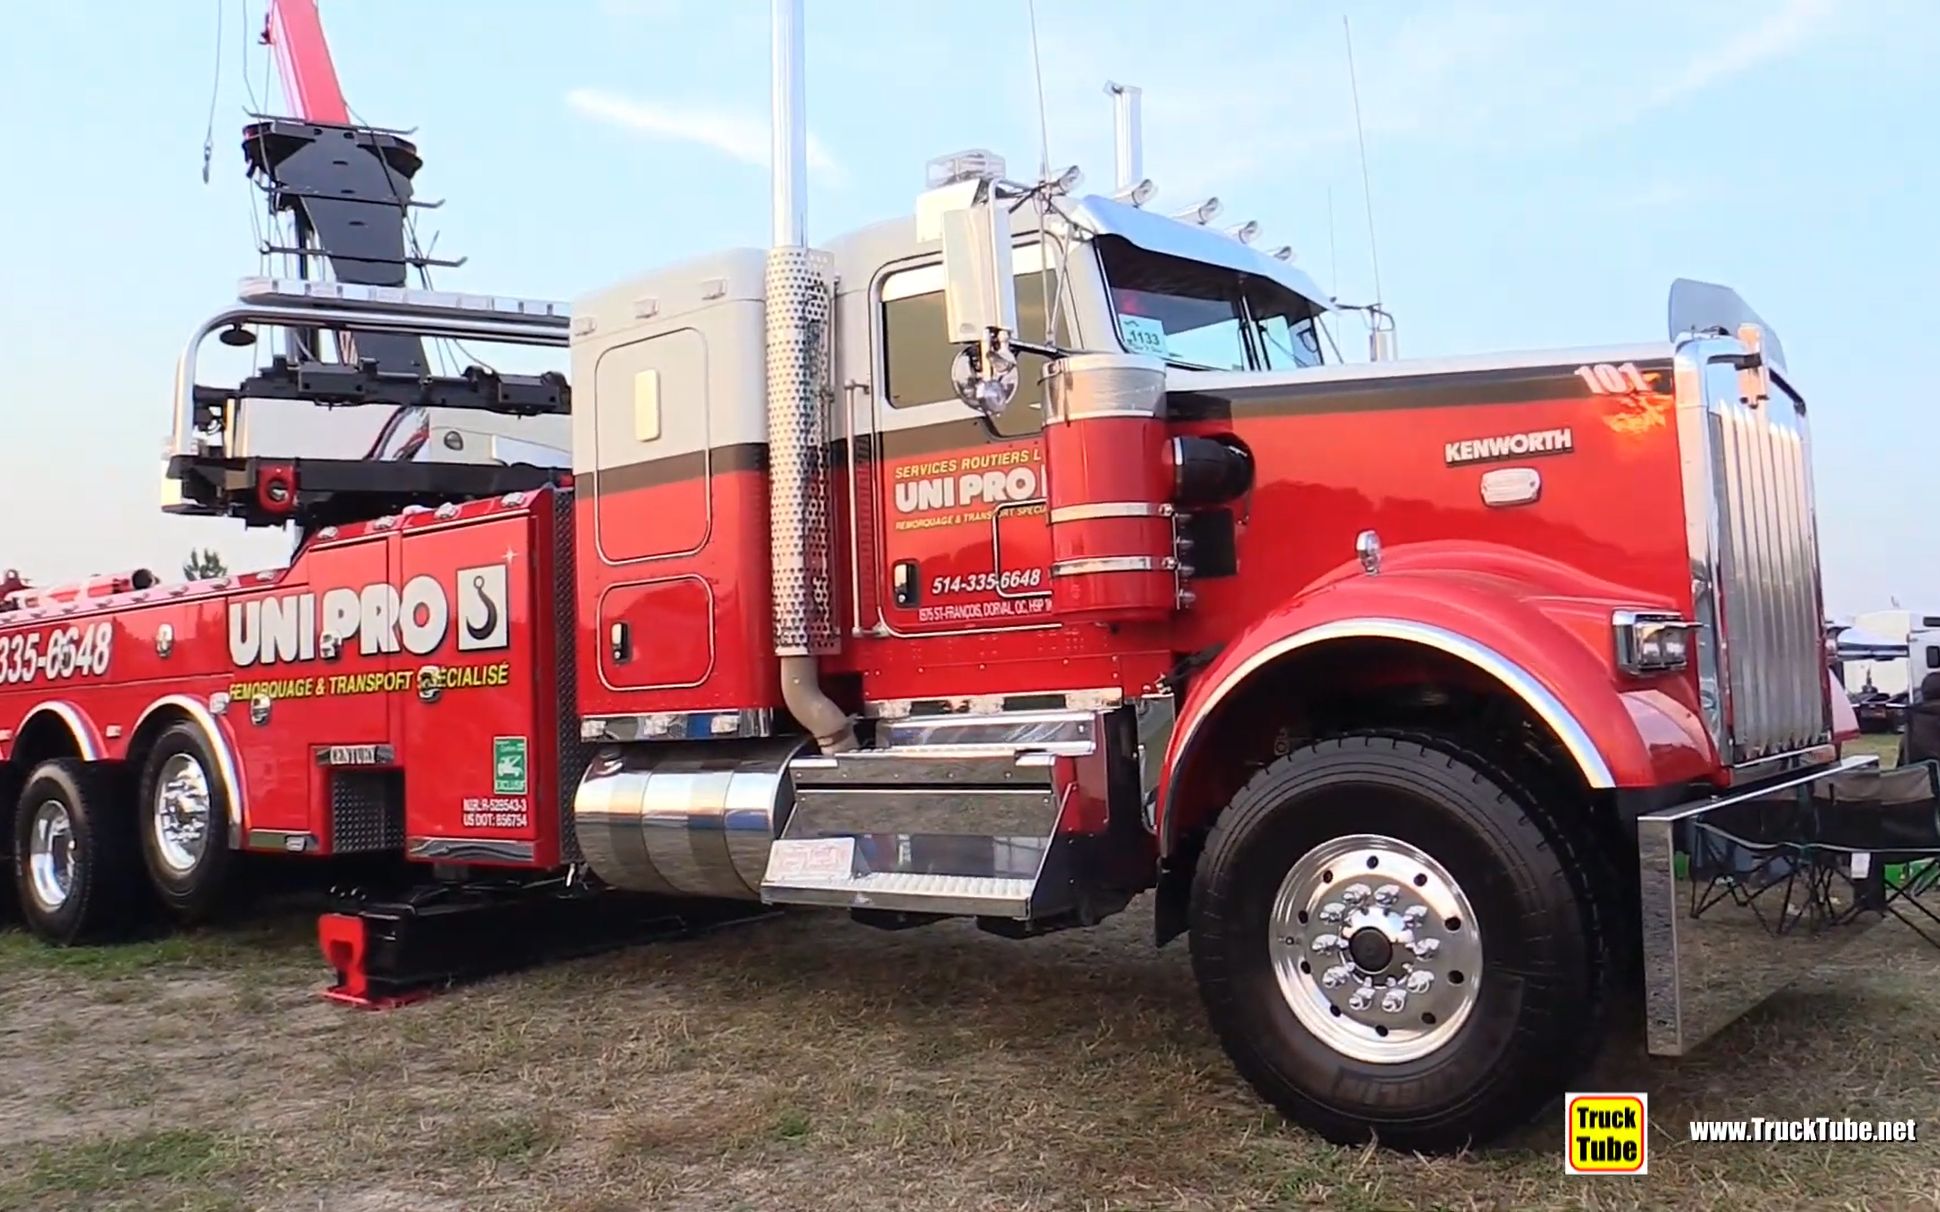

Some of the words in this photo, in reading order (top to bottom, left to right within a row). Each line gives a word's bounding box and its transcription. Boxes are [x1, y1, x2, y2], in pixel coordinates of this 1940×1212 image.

[1575, 362, 1649, 394] 101
[1445, 428, 1572, 463] KENWORTH
[895, 459, 957, 479] SERVICES
[961, 449, 1030, 471] ROUTIERS
[895, 476, 954, 513] UNI
[959, 466, 1036, 506] PRO
[932, 568, 1041, 594] 514-335-6648
[228, 592, 315, 667] UNI
[322, 574, 449, 657] PRO
[315, 677, 325, 696] &
[463, 813, 474, 827] US
